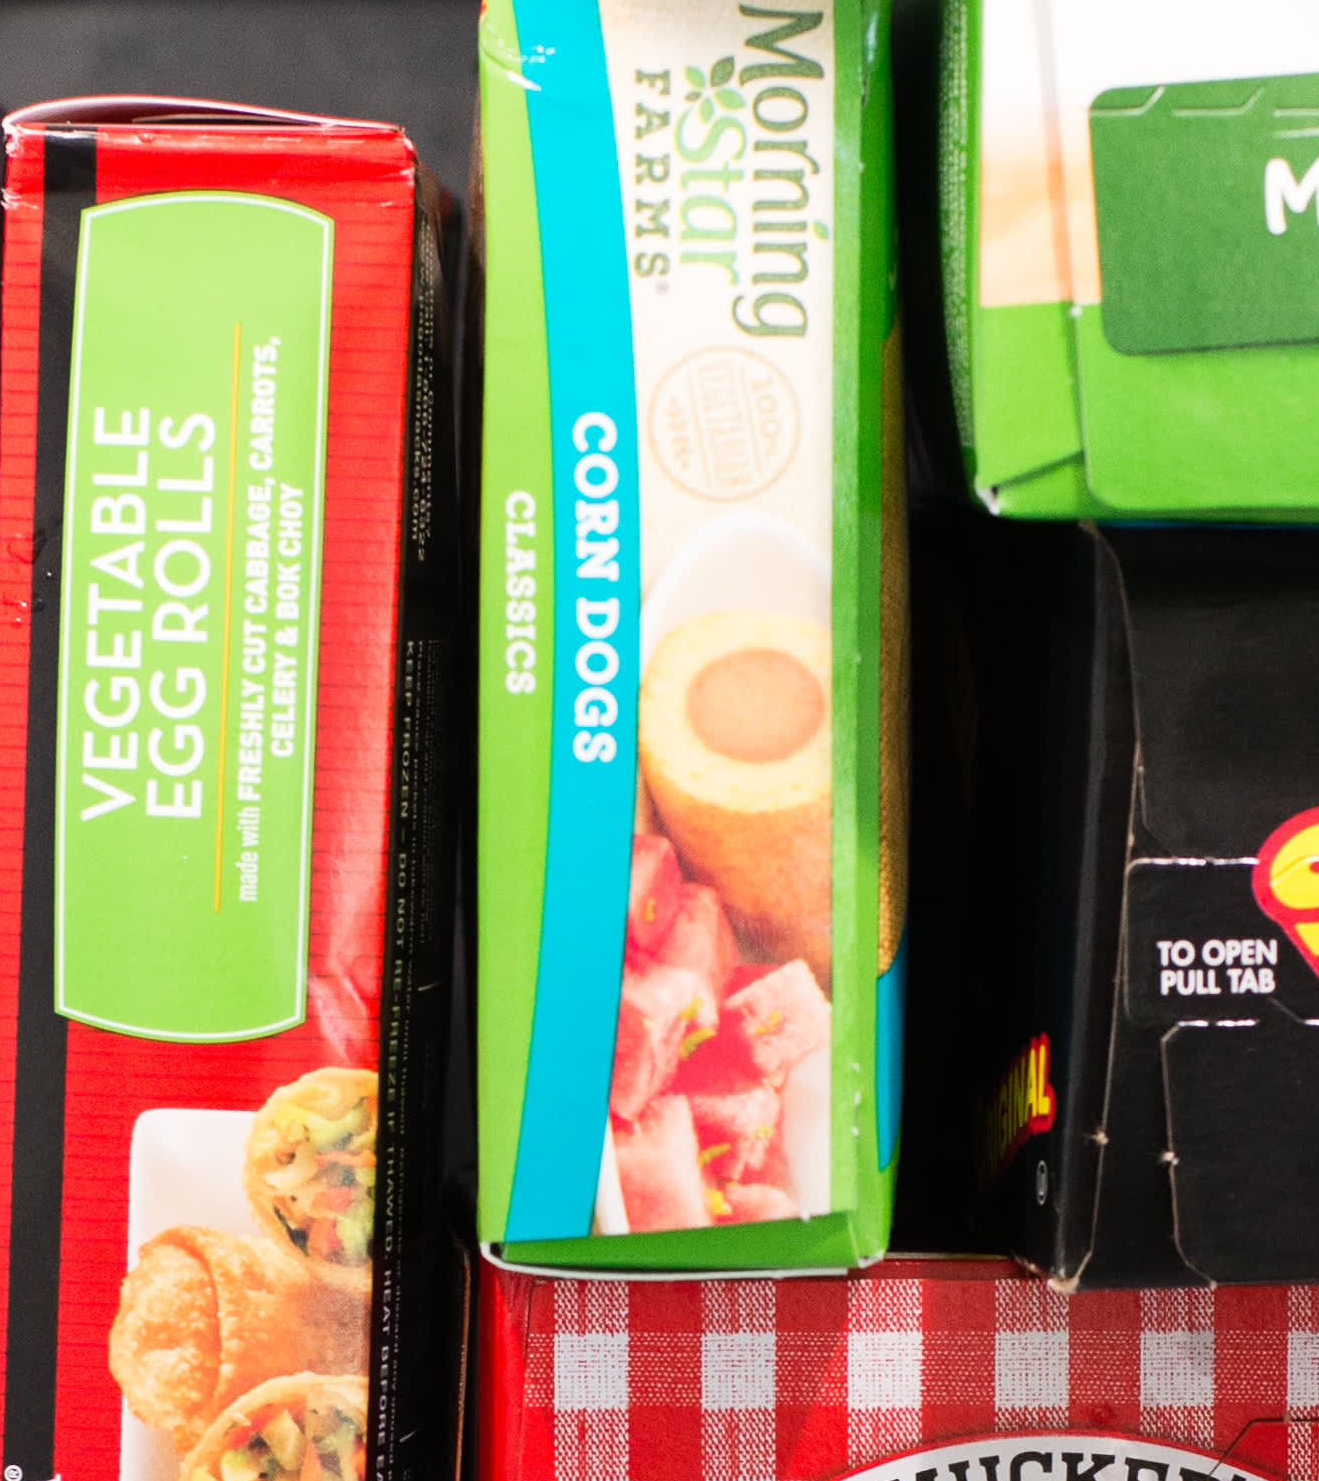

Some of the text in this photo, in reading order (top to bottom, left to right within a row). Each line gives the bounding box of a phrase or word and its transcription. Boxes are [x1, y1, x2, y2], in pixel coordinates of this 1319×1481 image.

[633, 69, 671, 277] FARMS
[675, 101, 748, 287] Star
[732, 1, 829, 339] Morning
[80, 405, 151, 822] VEGETABLE
[146, 412, 215, 820] EGG ROLLS
[235, 336, 282, 902] made with FRESHLY CUT CABBAGE, CARROTS,
[270, 481, 305, 758] CELERY & BOK CHOY
[505, 489, 537, 696] CLASSICS
[572, 411, 620, 763] CORN DOGS
[400, 715, 413, 818] FROZEN
[394, 897, 408, 949] NOT
[396, 852, 409, 888] DO
[1156, 938, 1278, 968] TO OPEN
[1160, 968, 1276, 995] PULL TAB
[377, 1344, 391, 1445] BEFORE
[382, 1269, 393, 1334] HEAT
